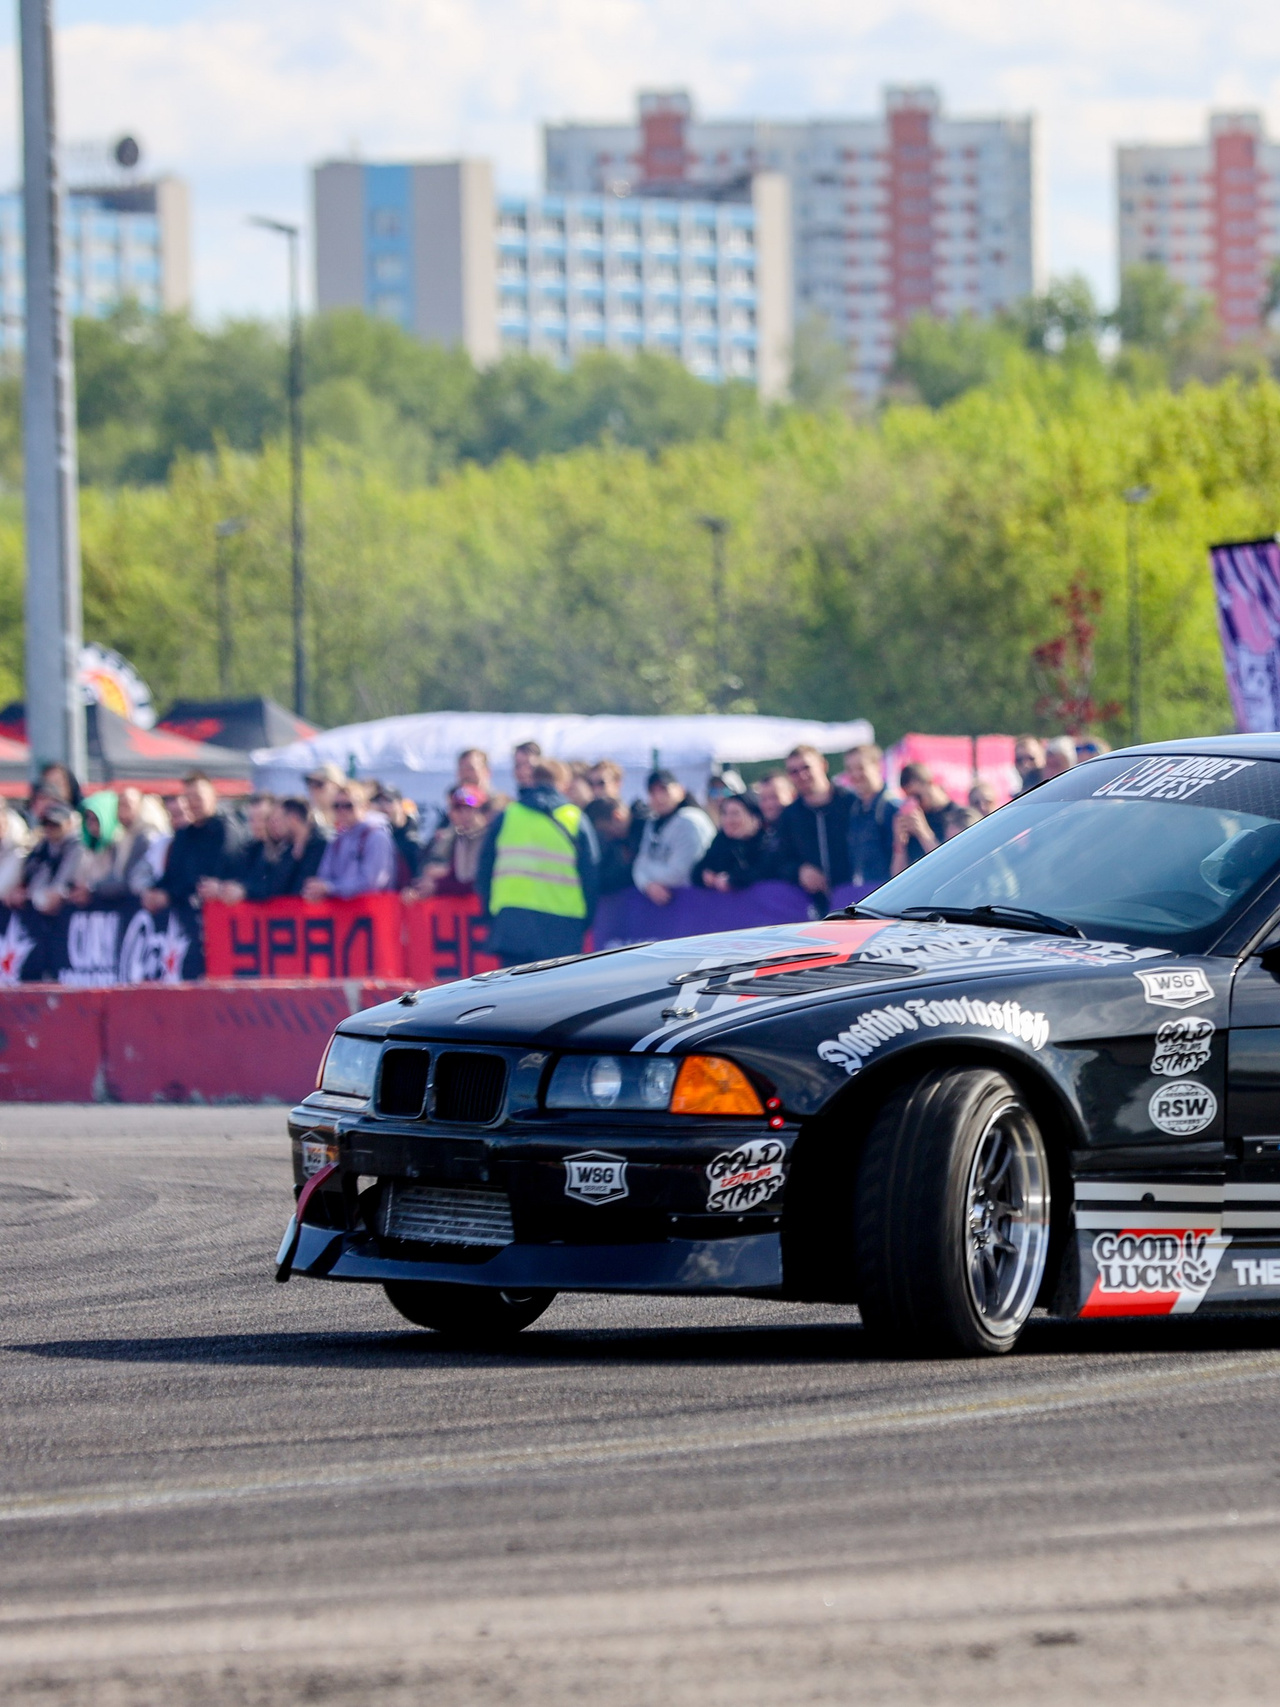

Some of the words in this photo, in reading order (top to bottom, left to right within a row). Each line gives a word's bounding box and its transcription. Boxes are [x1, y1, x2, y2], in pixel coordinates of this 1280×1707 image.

[1168, 756, 1257, 781] DRIFT
[1140, 776, 1217, 800] FEST
[229, 916, 373, 978] УРАЛ
[1153, 974, 1195, 989] WSG
[1157, 1021, 1213, 1043] GOLD
[1152, 1050, 1208, 1071] STAFF
[1157, 1098, 1208, 1118] RSW
[710, 1142, 782, 1180] GOLD
[576, 1166, 614, 1183] WSG
[709, 1174, 782, 1212] STAFF
[1097, 1236, 1179, 1261] GOOD
[1101, 1264, 1182, 1289] LUCK
